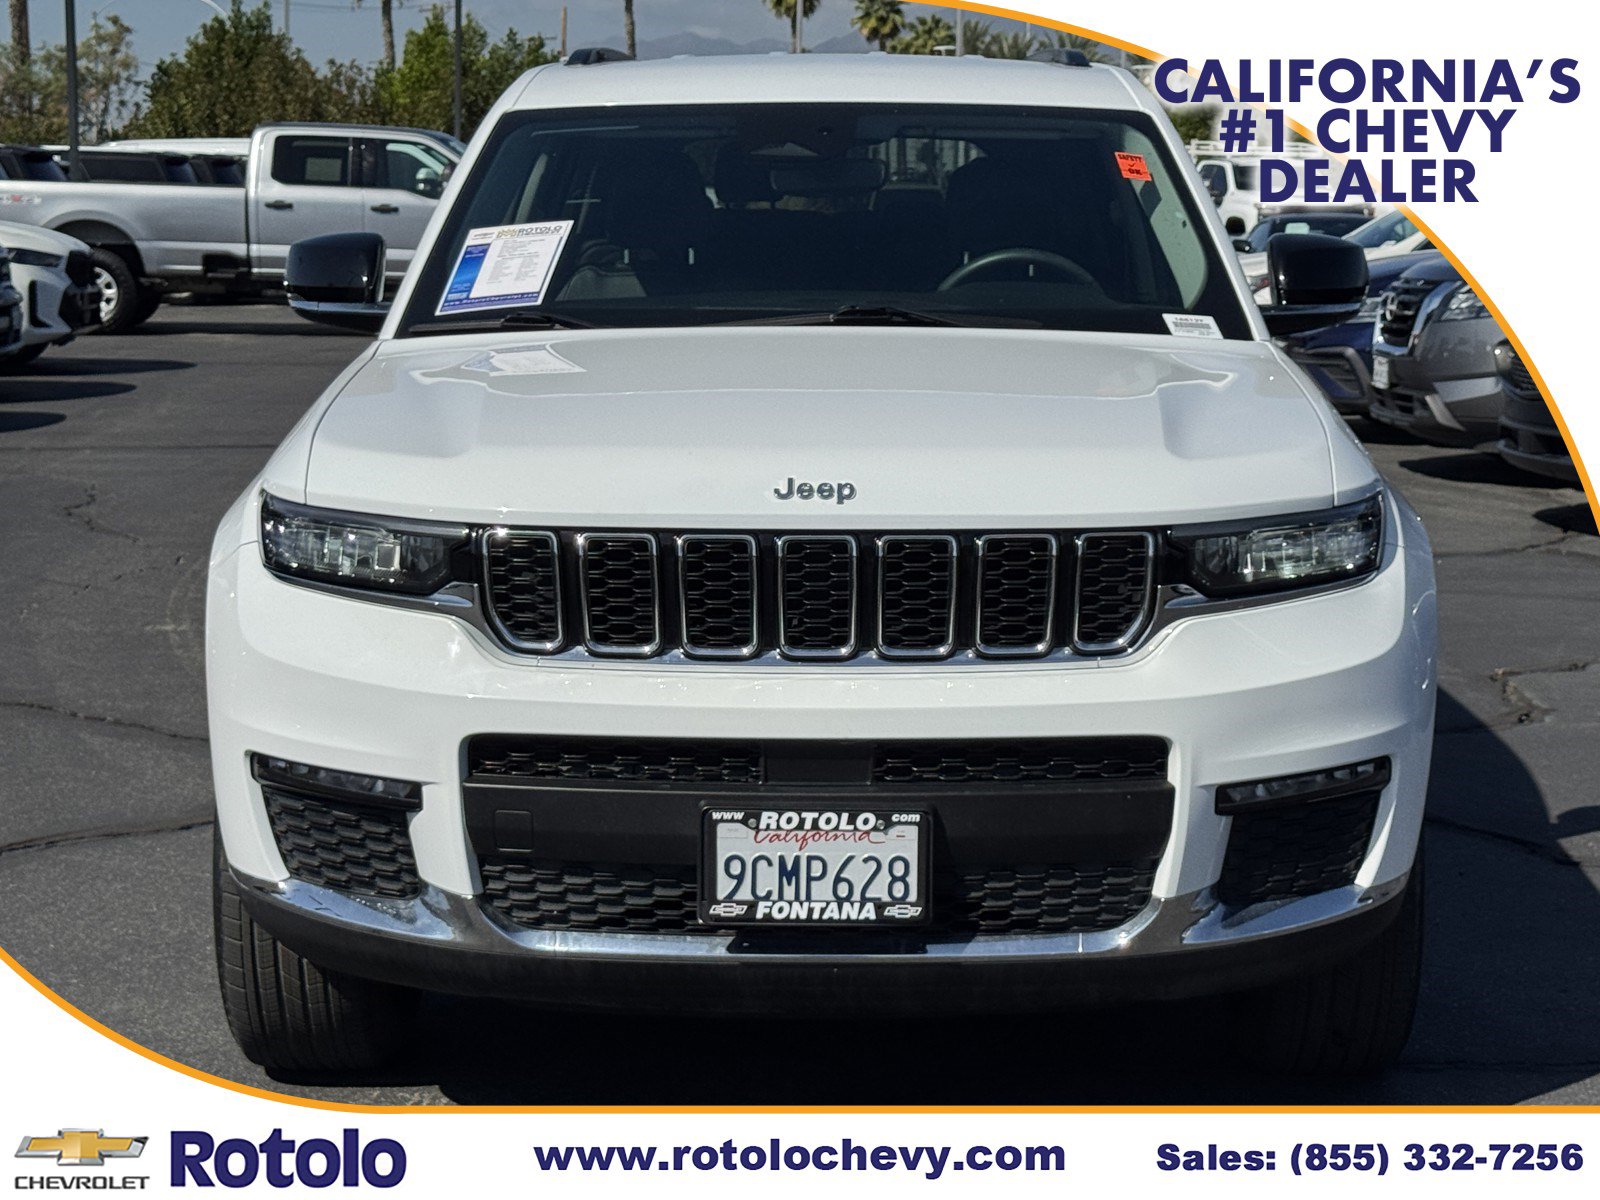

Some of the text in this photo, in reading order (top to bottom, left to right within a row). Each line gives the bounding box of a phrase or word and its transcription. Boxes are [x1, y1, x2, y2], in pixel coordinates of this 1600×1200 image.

[1118, 154, 1142, 162] SAFETY
[518, 226, 562, 235] ROTOLO
[773, 477, 857, 505] Jeep
[711, 811, 745, 821] www
[759, 812, 876, 830] ROTOLO
[891, 813, 921, 823] com
[753, 829, 886, 852] California
[723, 853, 911, 902] 9CMP628
[755, 901, 877, 921] FONTANA
